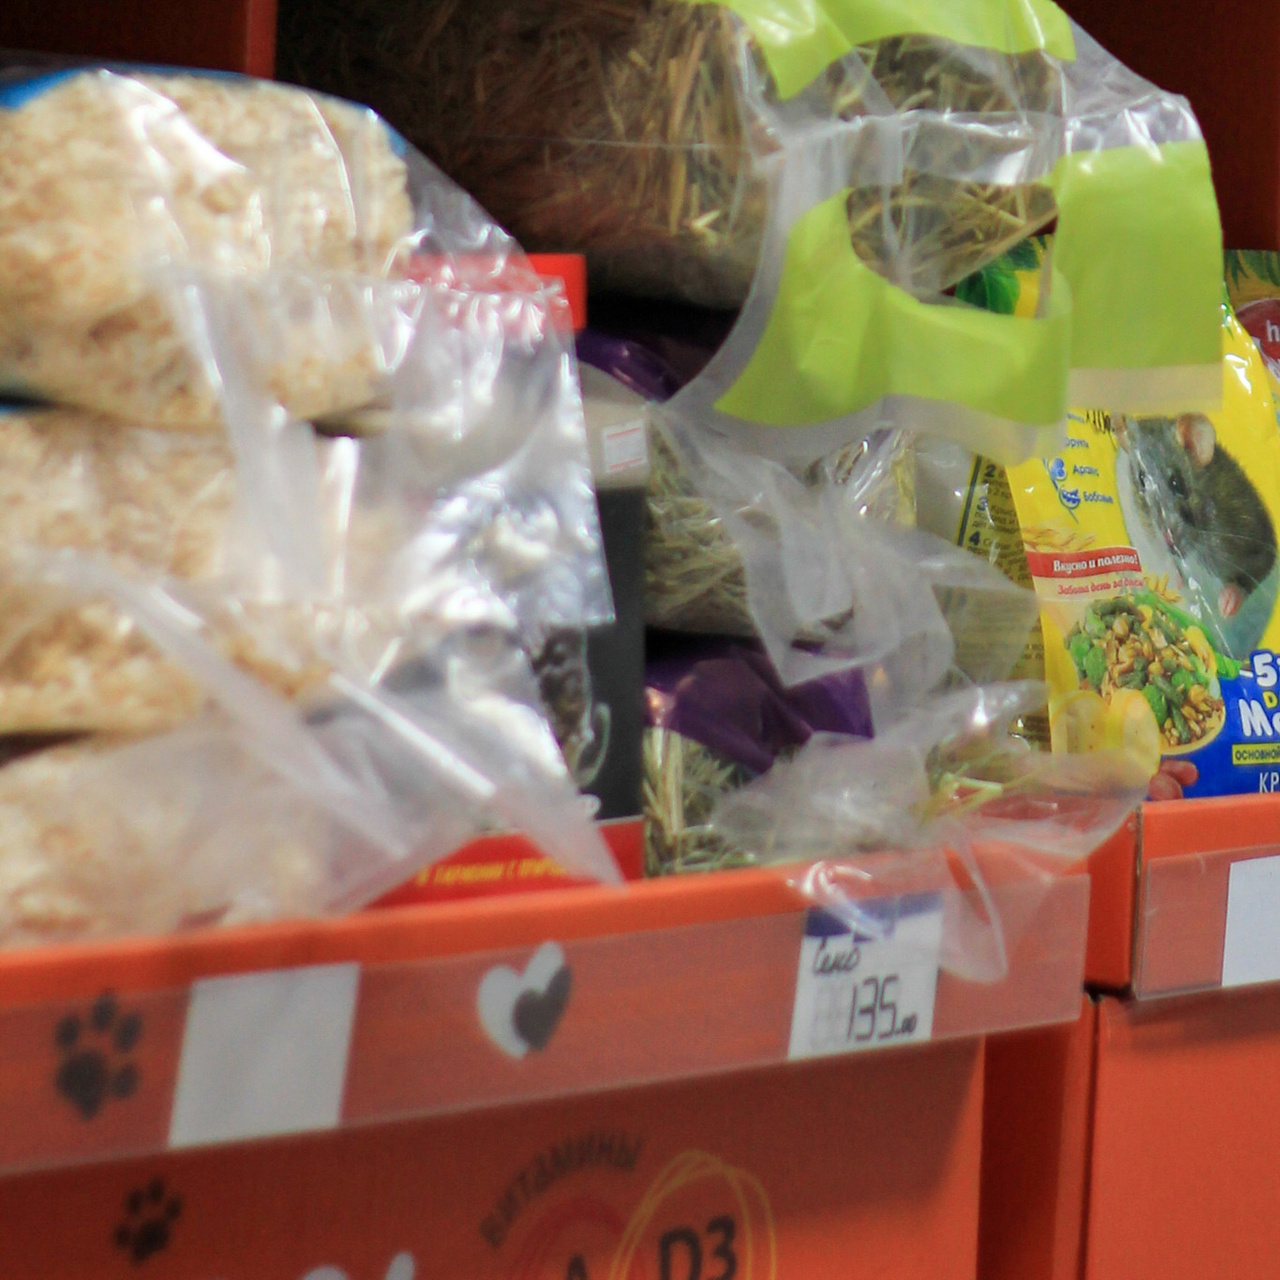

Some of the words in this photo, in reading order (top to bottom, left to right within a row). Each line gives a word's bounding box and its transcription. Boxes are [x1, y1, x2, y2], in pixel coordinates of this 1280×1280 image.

[1053, 558, 1088, 574] Вкусно
[1088, 559, 1097, 569] и
[1097, 553, 1139, 568] полезно!
